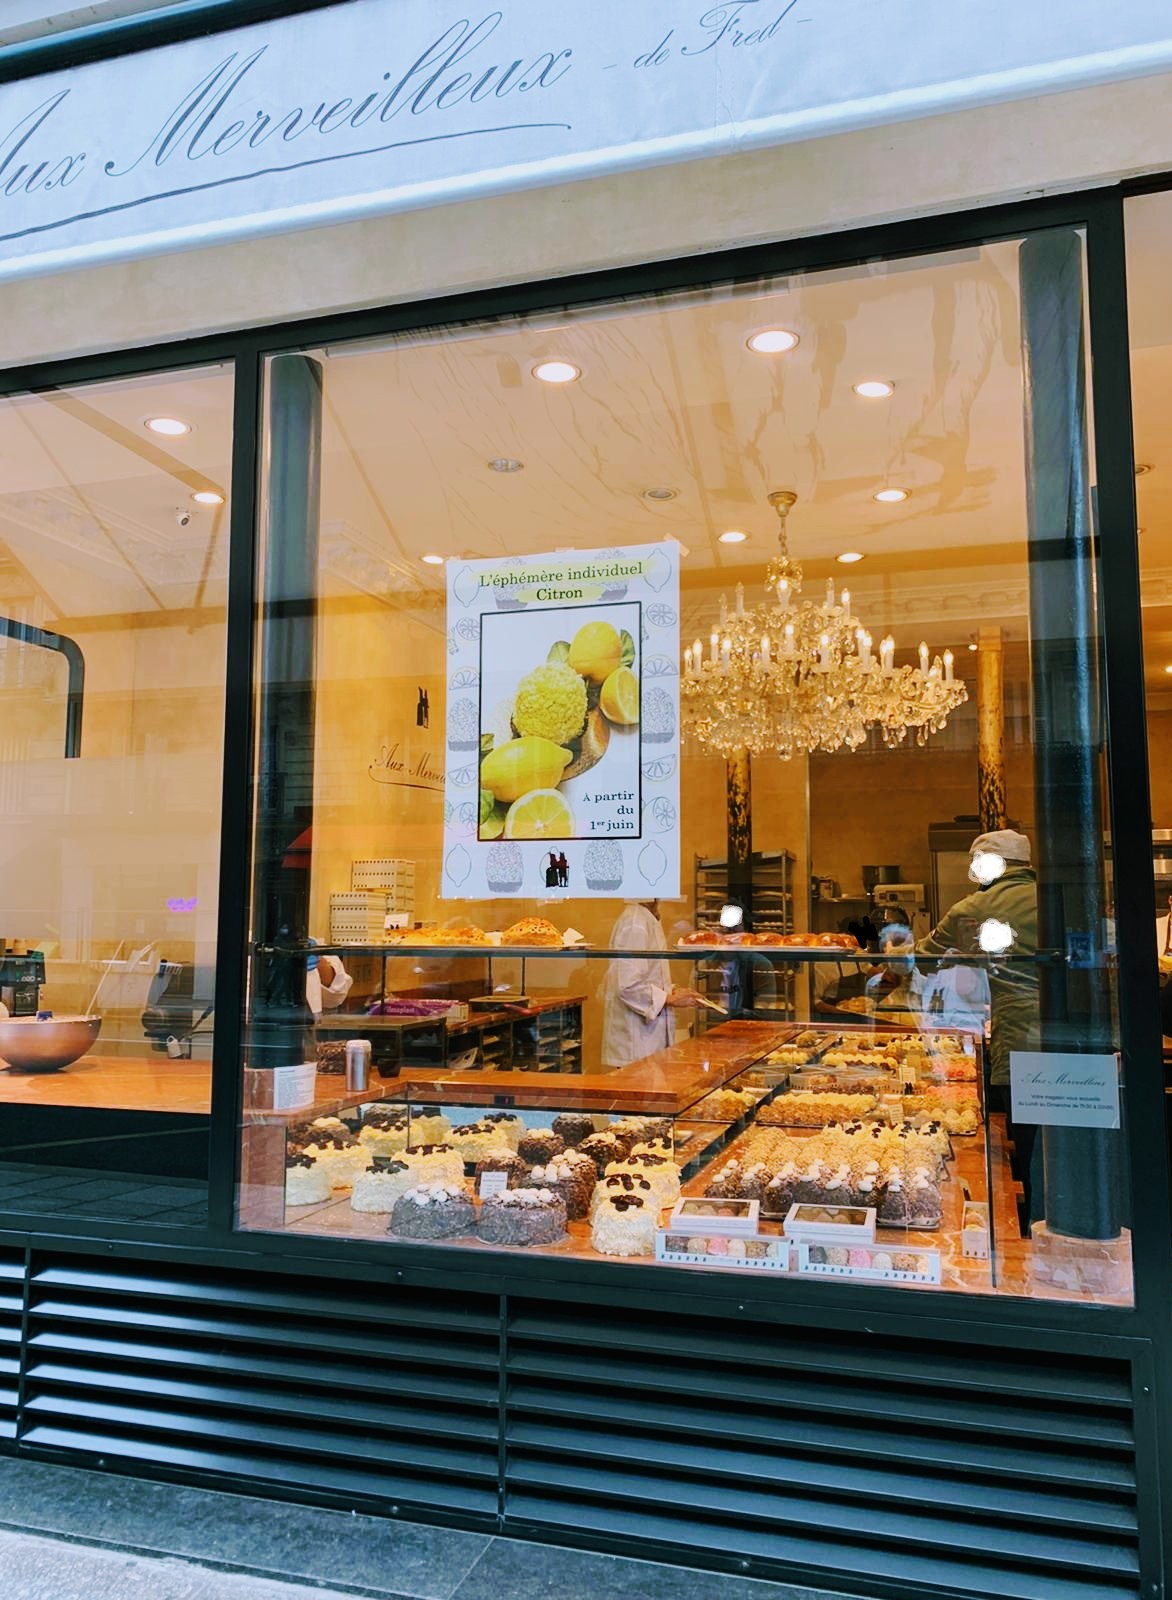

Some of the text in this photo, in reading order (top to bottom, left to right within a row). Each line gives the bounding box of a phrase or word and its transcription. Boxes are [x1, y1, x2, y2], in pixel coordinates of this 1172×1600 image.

[105, 11, 573, 177] Merveilleux
[632, 29, 675, 69] de
[681, 0, 798, 56] Fred
[479, 561, 643, 589] L'éphémère individuel
[536, 587, 583, 602] Citron
[374, 743, 405, 772] Aux
[594, 790, 635, 804] partir
[616, 804, 634, 815] du
[606, 819, 634, 832] juin
